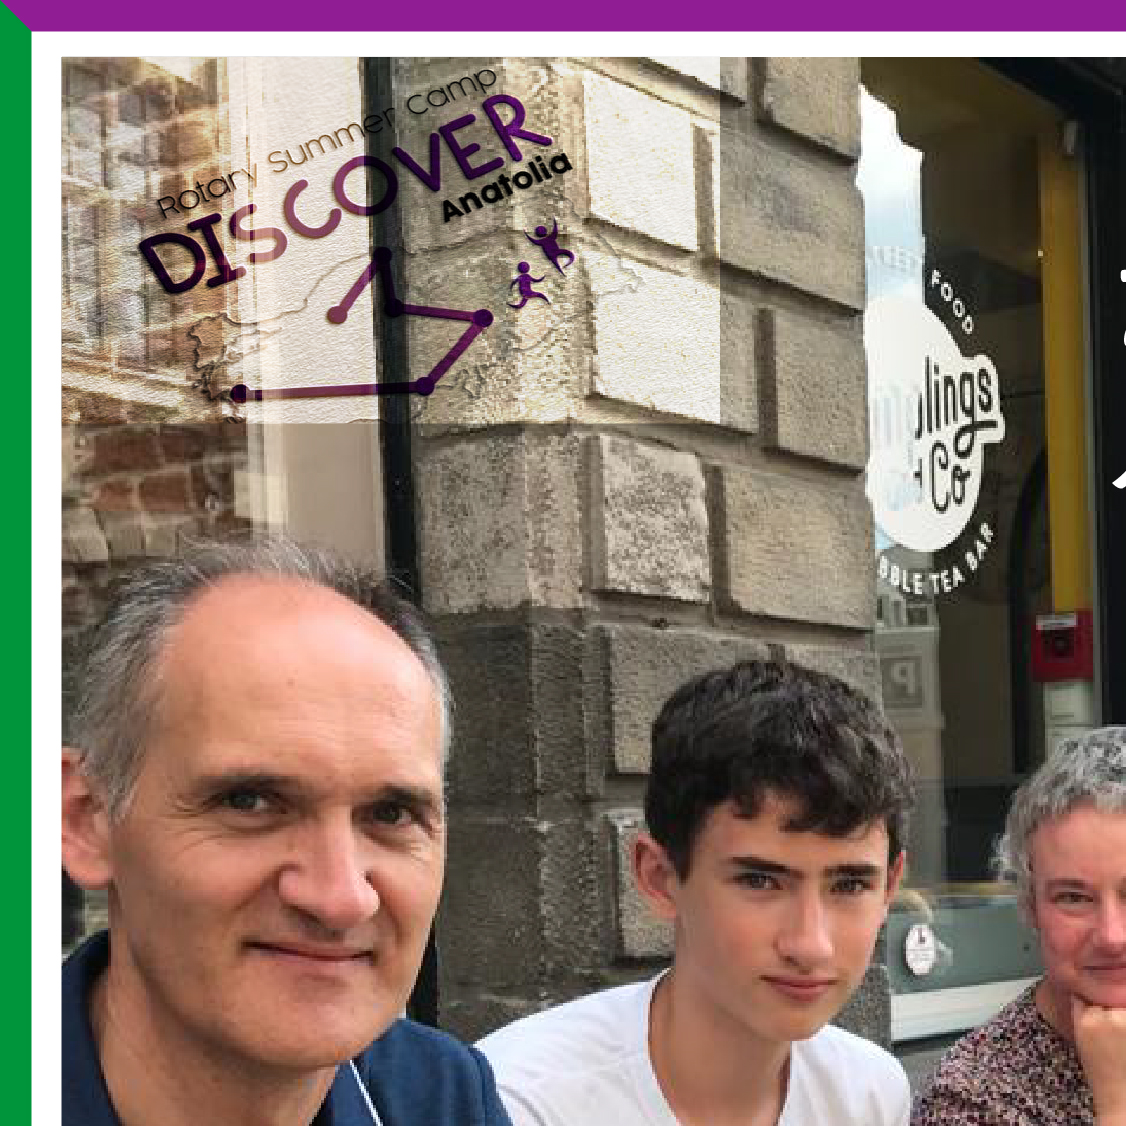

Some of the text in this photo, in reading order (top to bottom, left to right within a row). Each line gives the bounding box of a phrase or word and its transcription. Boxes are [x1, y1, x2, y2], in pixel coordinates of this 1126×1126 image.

[931, 269, 975, 335] FOOD
[931, 440, 971, 514] Co
[877, 521, 994, 596] BBLE TEA BAR
